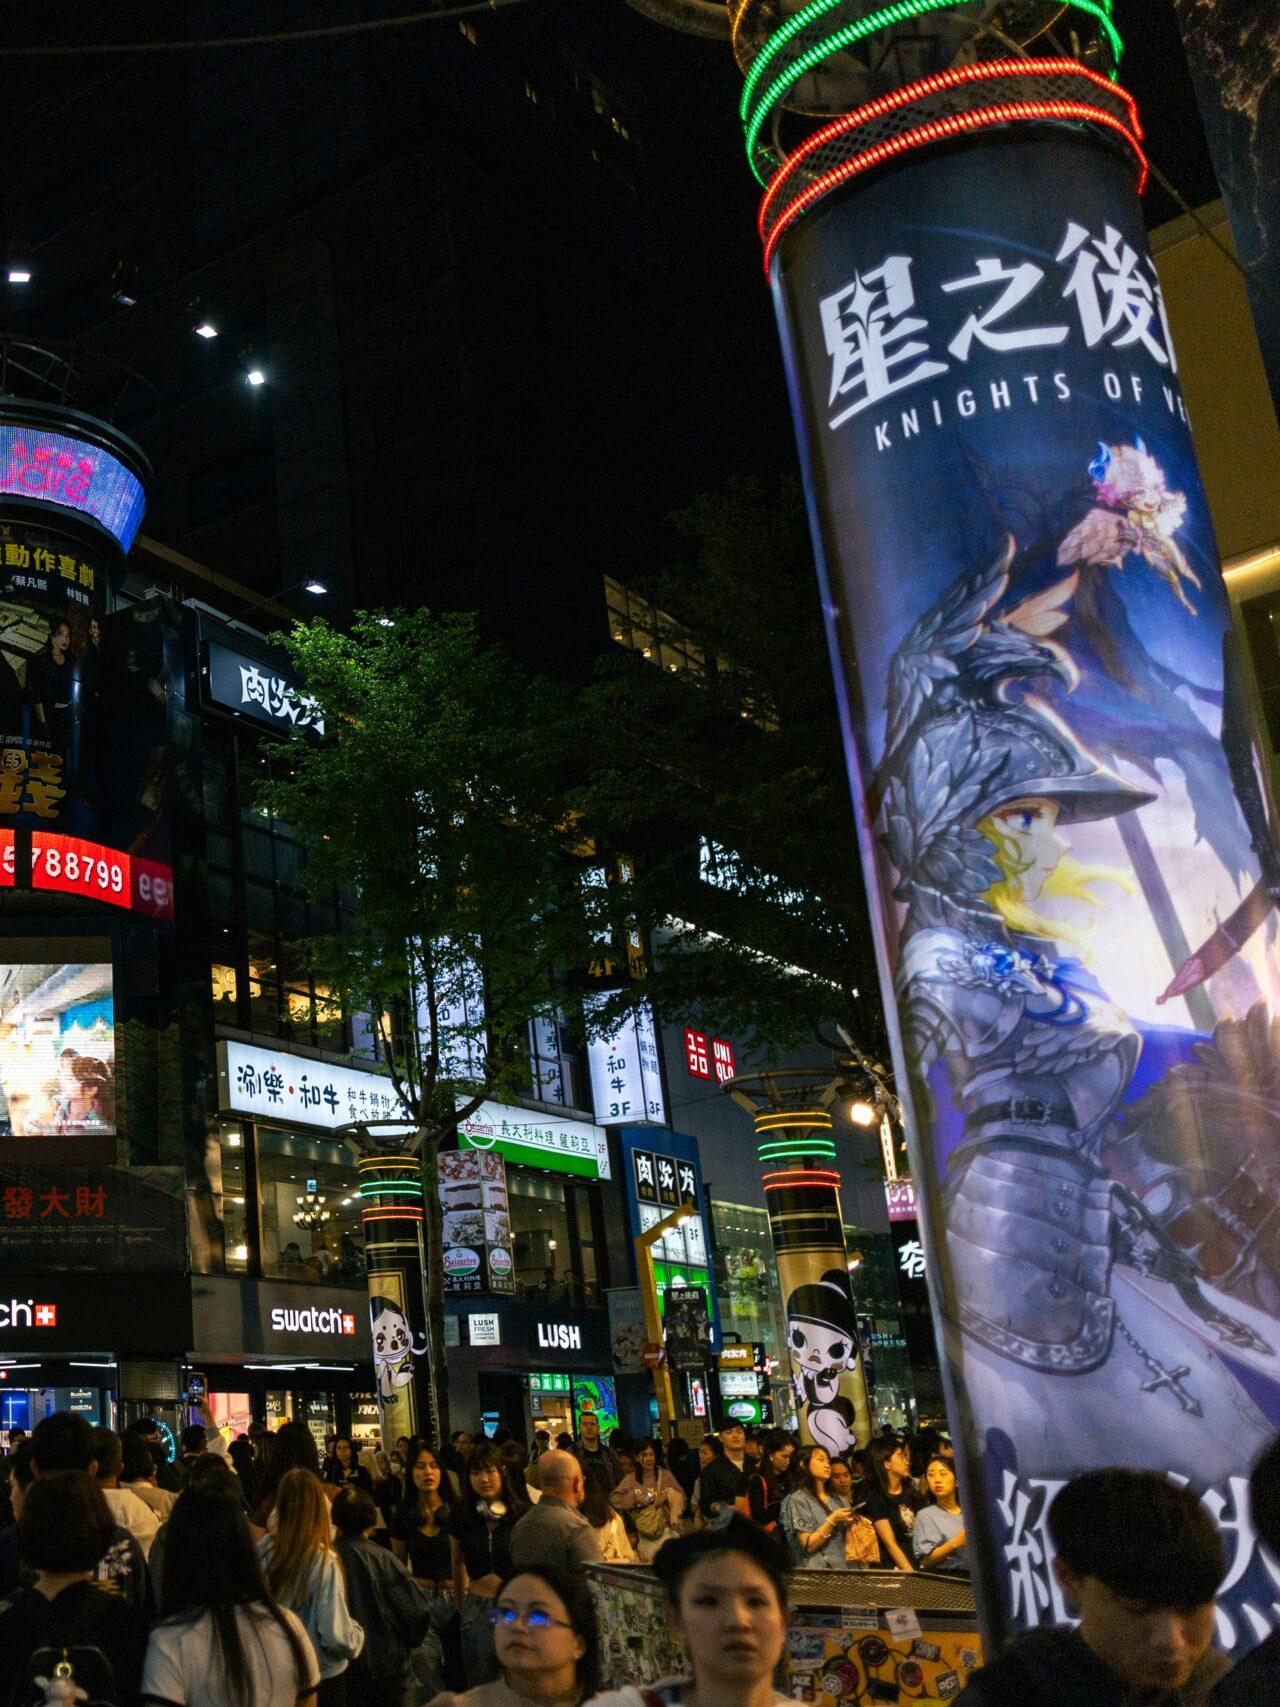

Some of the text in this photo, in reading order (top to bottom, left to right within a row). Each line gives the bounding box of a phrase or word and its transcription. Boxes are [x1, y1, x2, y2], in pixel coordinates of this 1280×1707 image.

[820, 221, 1177, 430] 星之後
[875, 371, 1072, 451] KNIGHTS
[1103, 373, 1143, 403] OF
[713, 1042, 732, 1063] UNI
[610, 1100, 631, 1117] 3F
[649, 1100, 660, 1117] 3F
[597, 1143, 606, 1154] 2F
[636, 1154, 696, 1197] 肉次方
[688, 1227, 700, 1242] 3F
[271, 1306, 343, 1334] swatch
[537, 1322, 582, 1350] LUSH
